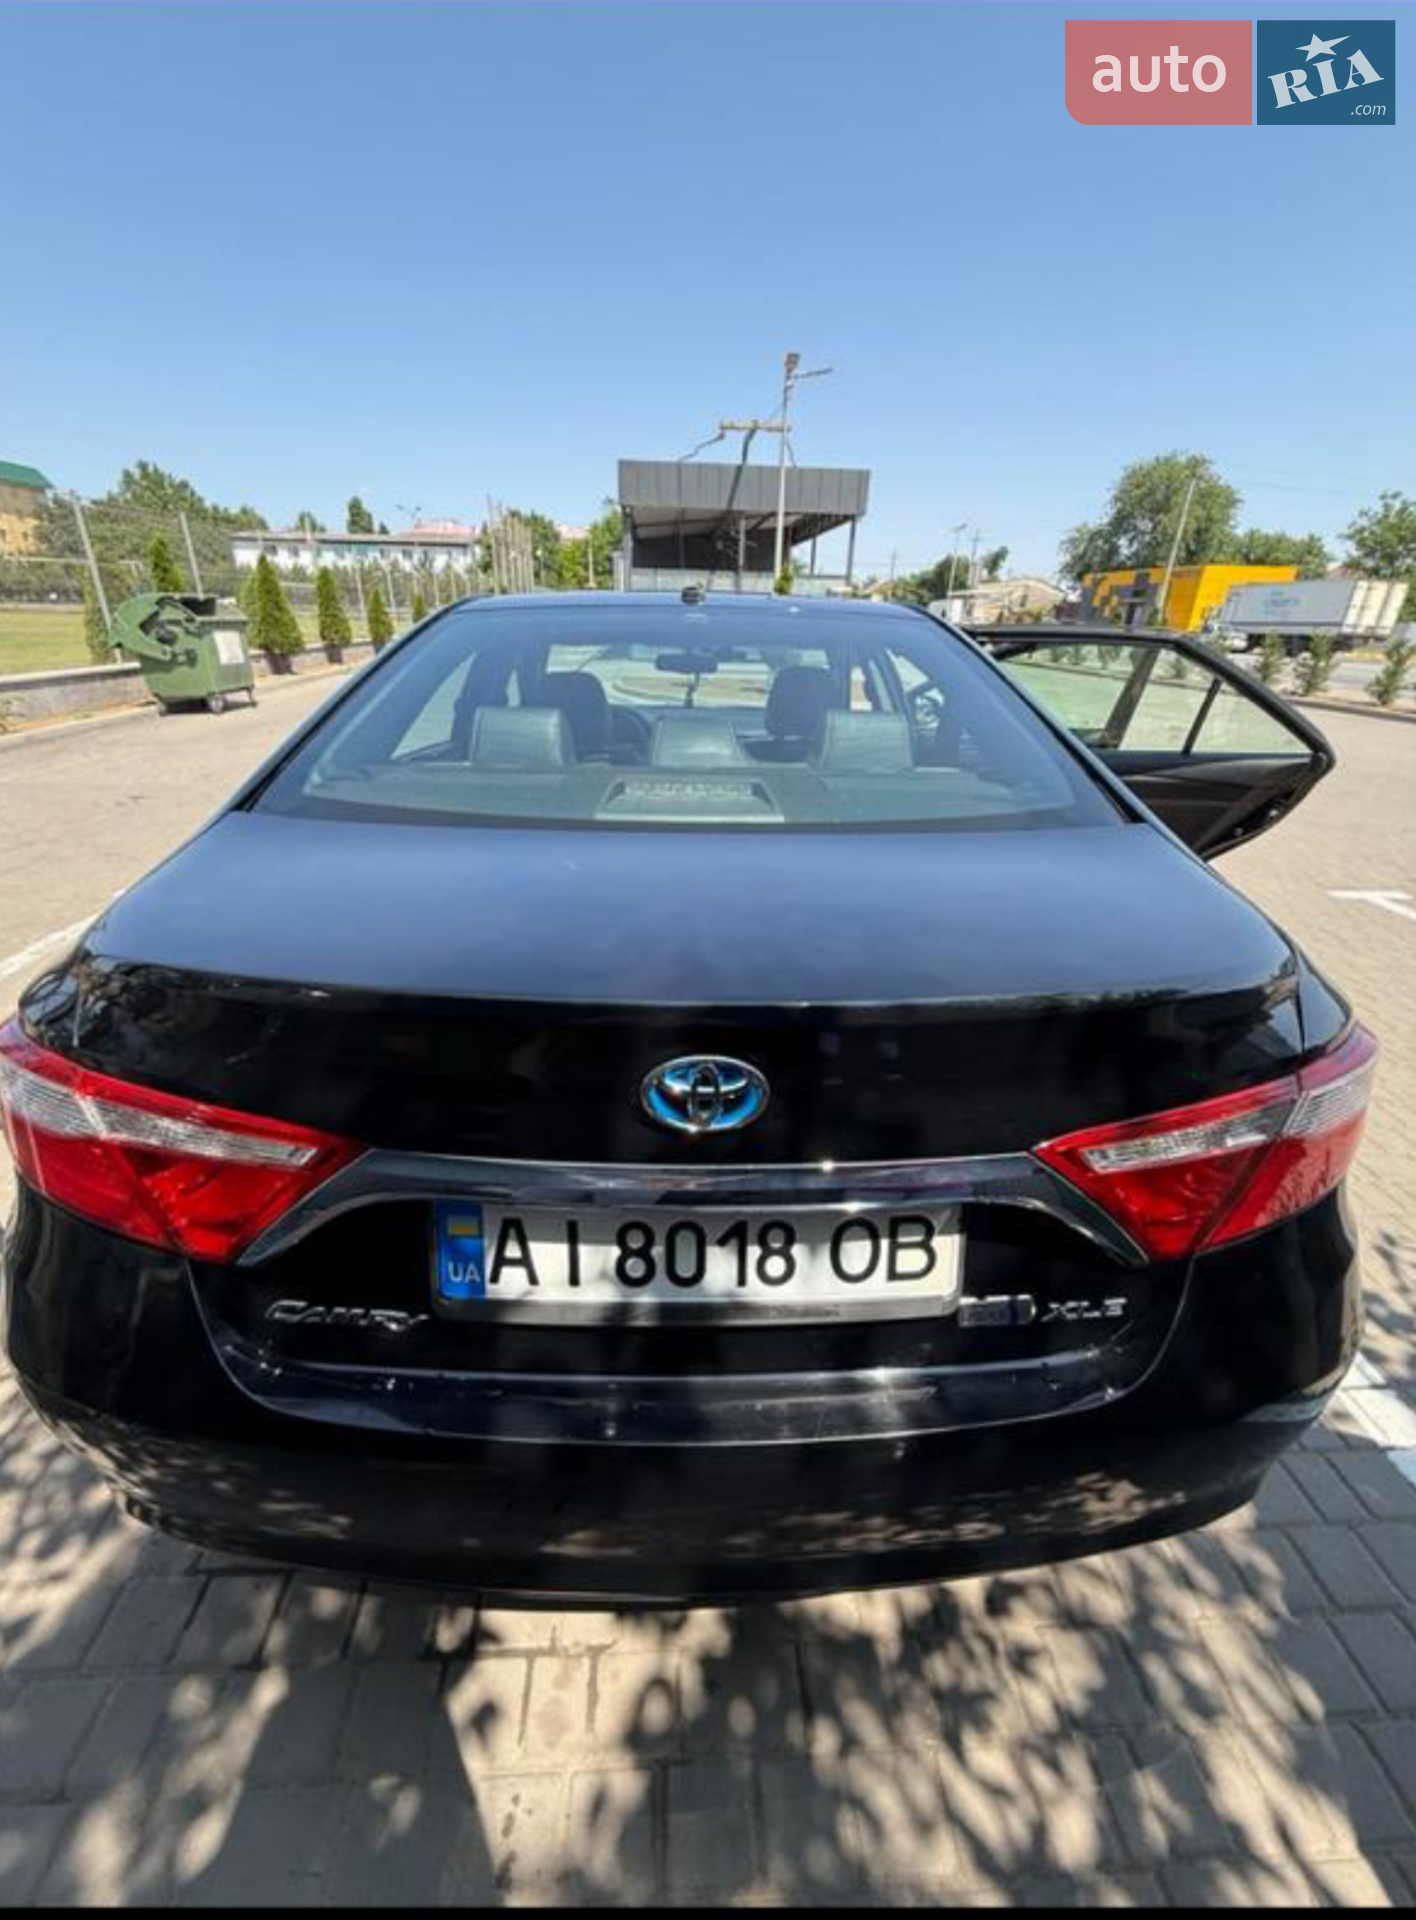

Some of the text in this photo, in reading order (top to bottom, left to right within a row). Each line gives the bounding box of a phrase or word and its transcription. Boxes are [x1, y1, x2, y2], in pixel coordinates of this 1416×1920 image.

[448, 1261, 481, 1283] UA
[615, 1219, 797, 1288] 8018
[829, 1215, 938, 1284] OB
